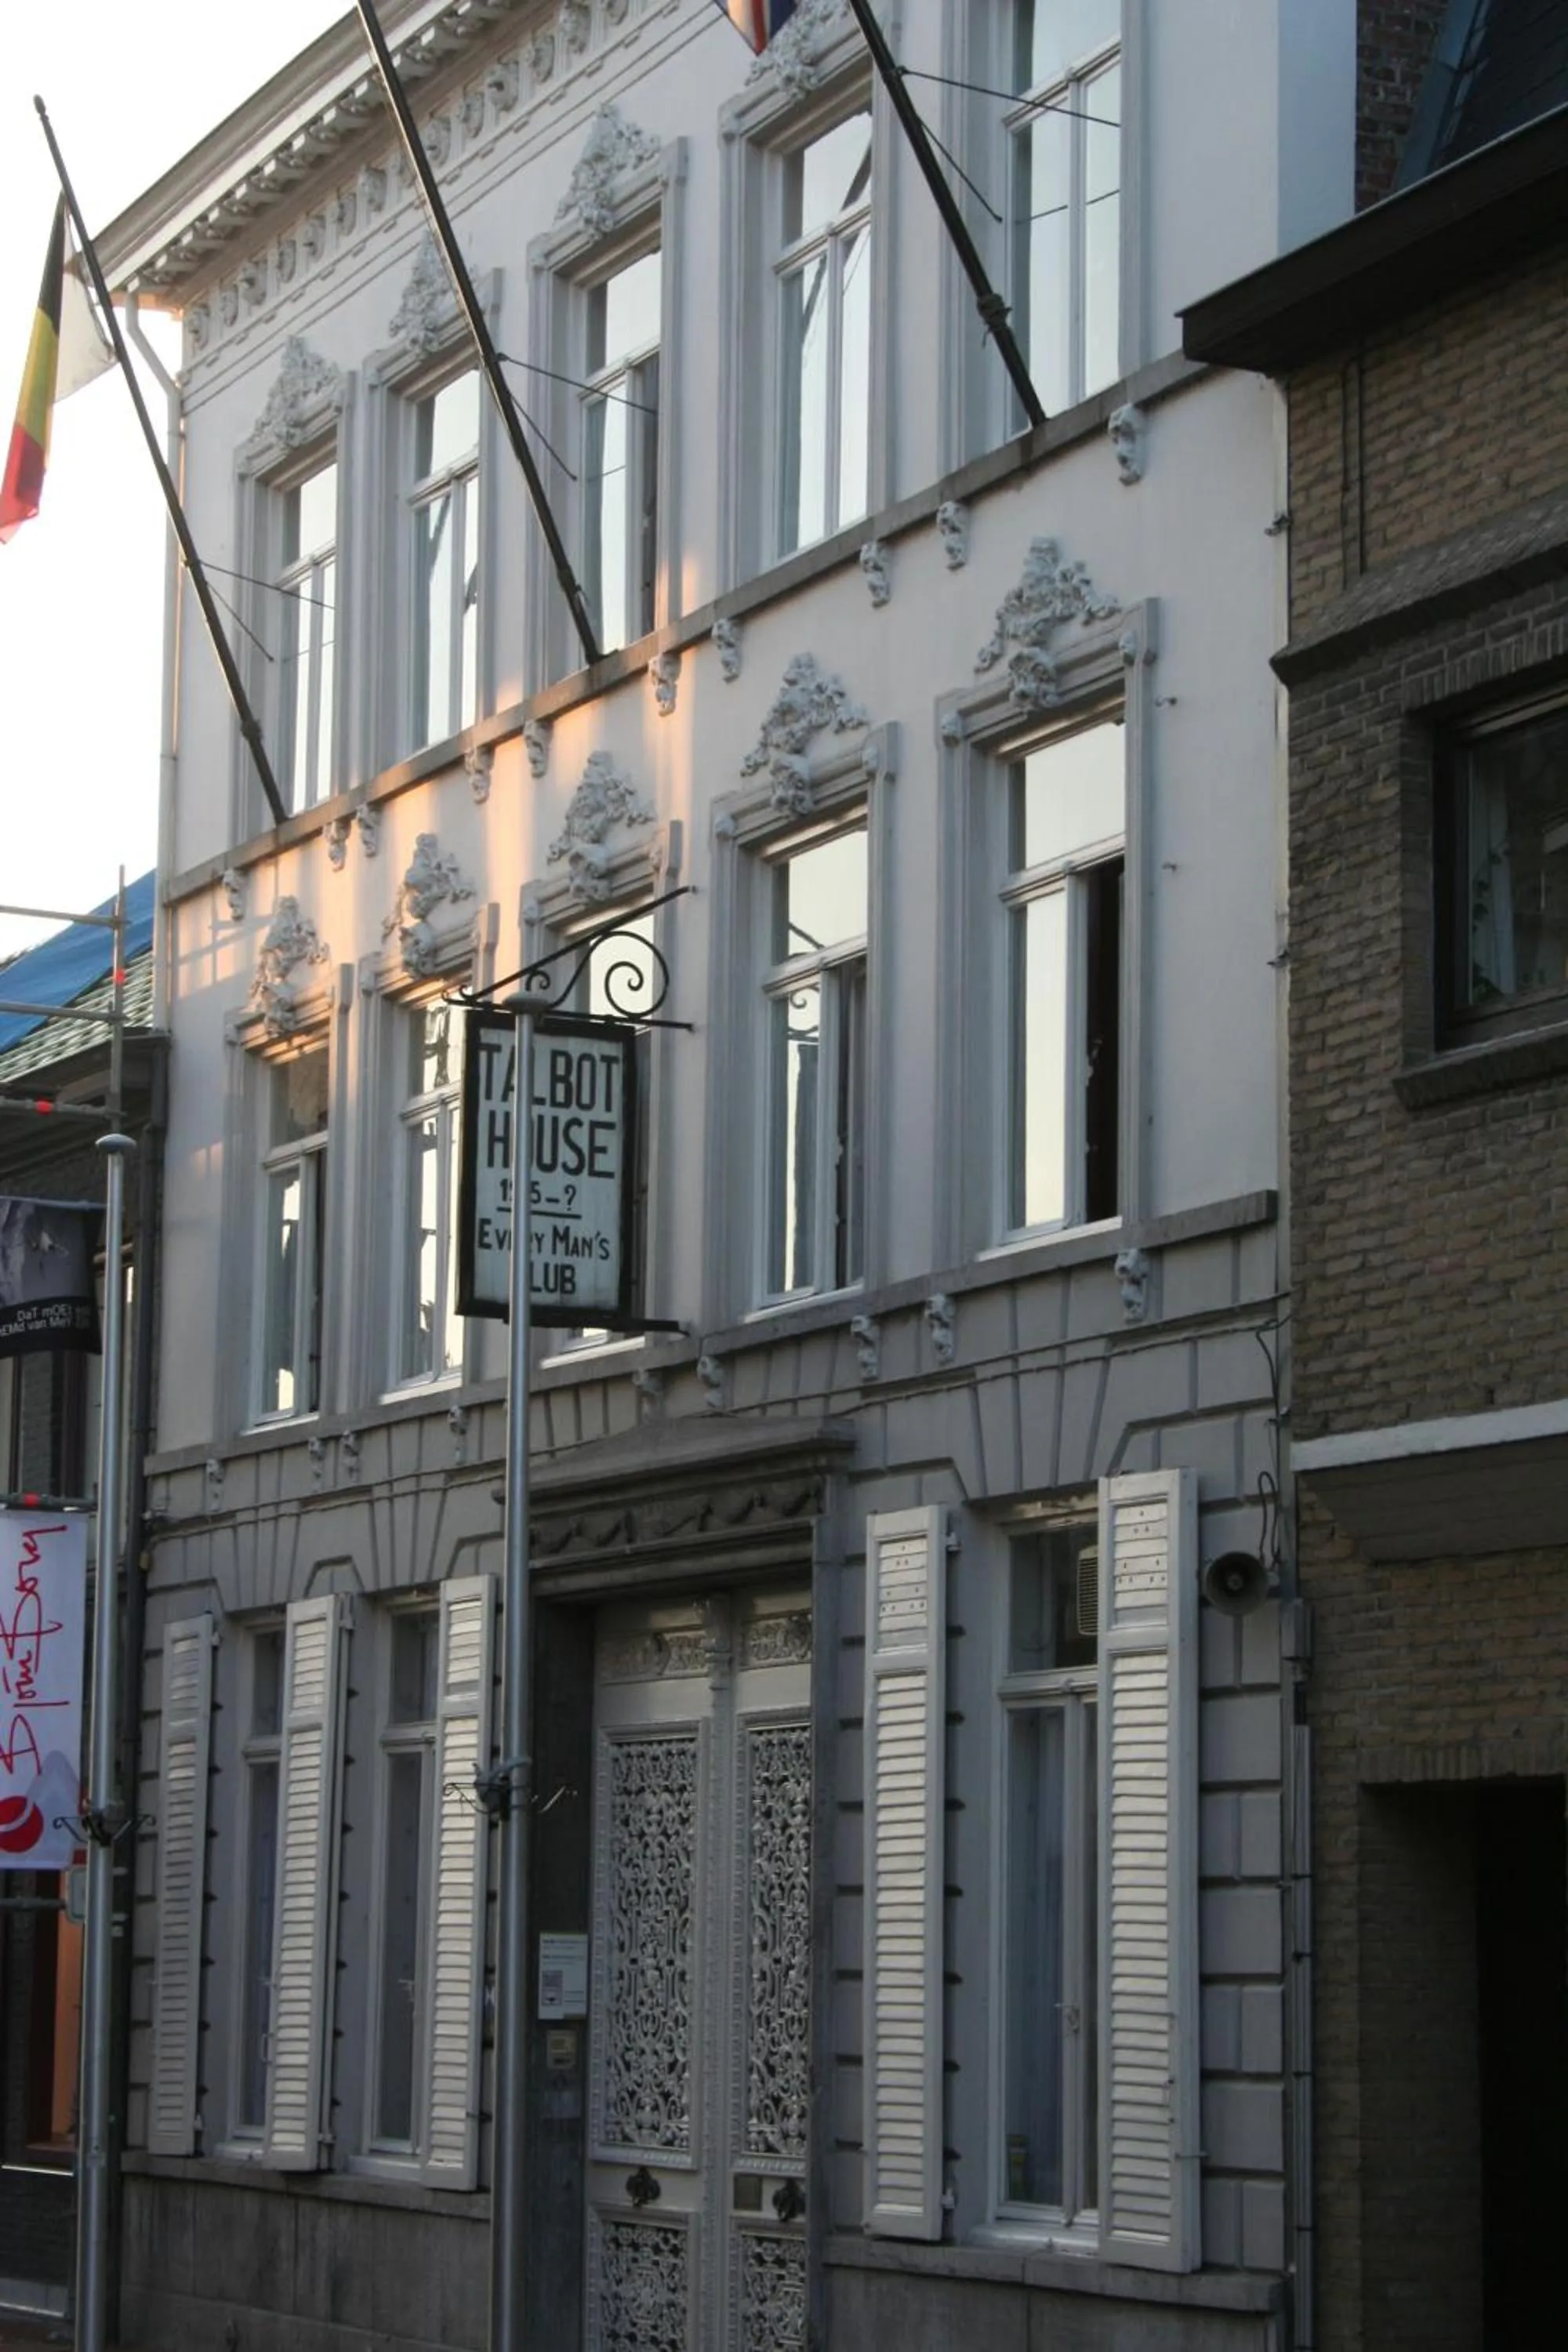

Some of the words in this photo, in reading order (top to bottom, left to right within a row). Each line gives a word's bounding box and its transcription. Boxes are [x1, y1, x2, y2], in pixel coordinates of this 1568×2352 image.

[488, 1109, 616, 1178] HUSE
[477, 1218, 545, 1254] EVY
[528, 1260, 577, 1294] LUB
